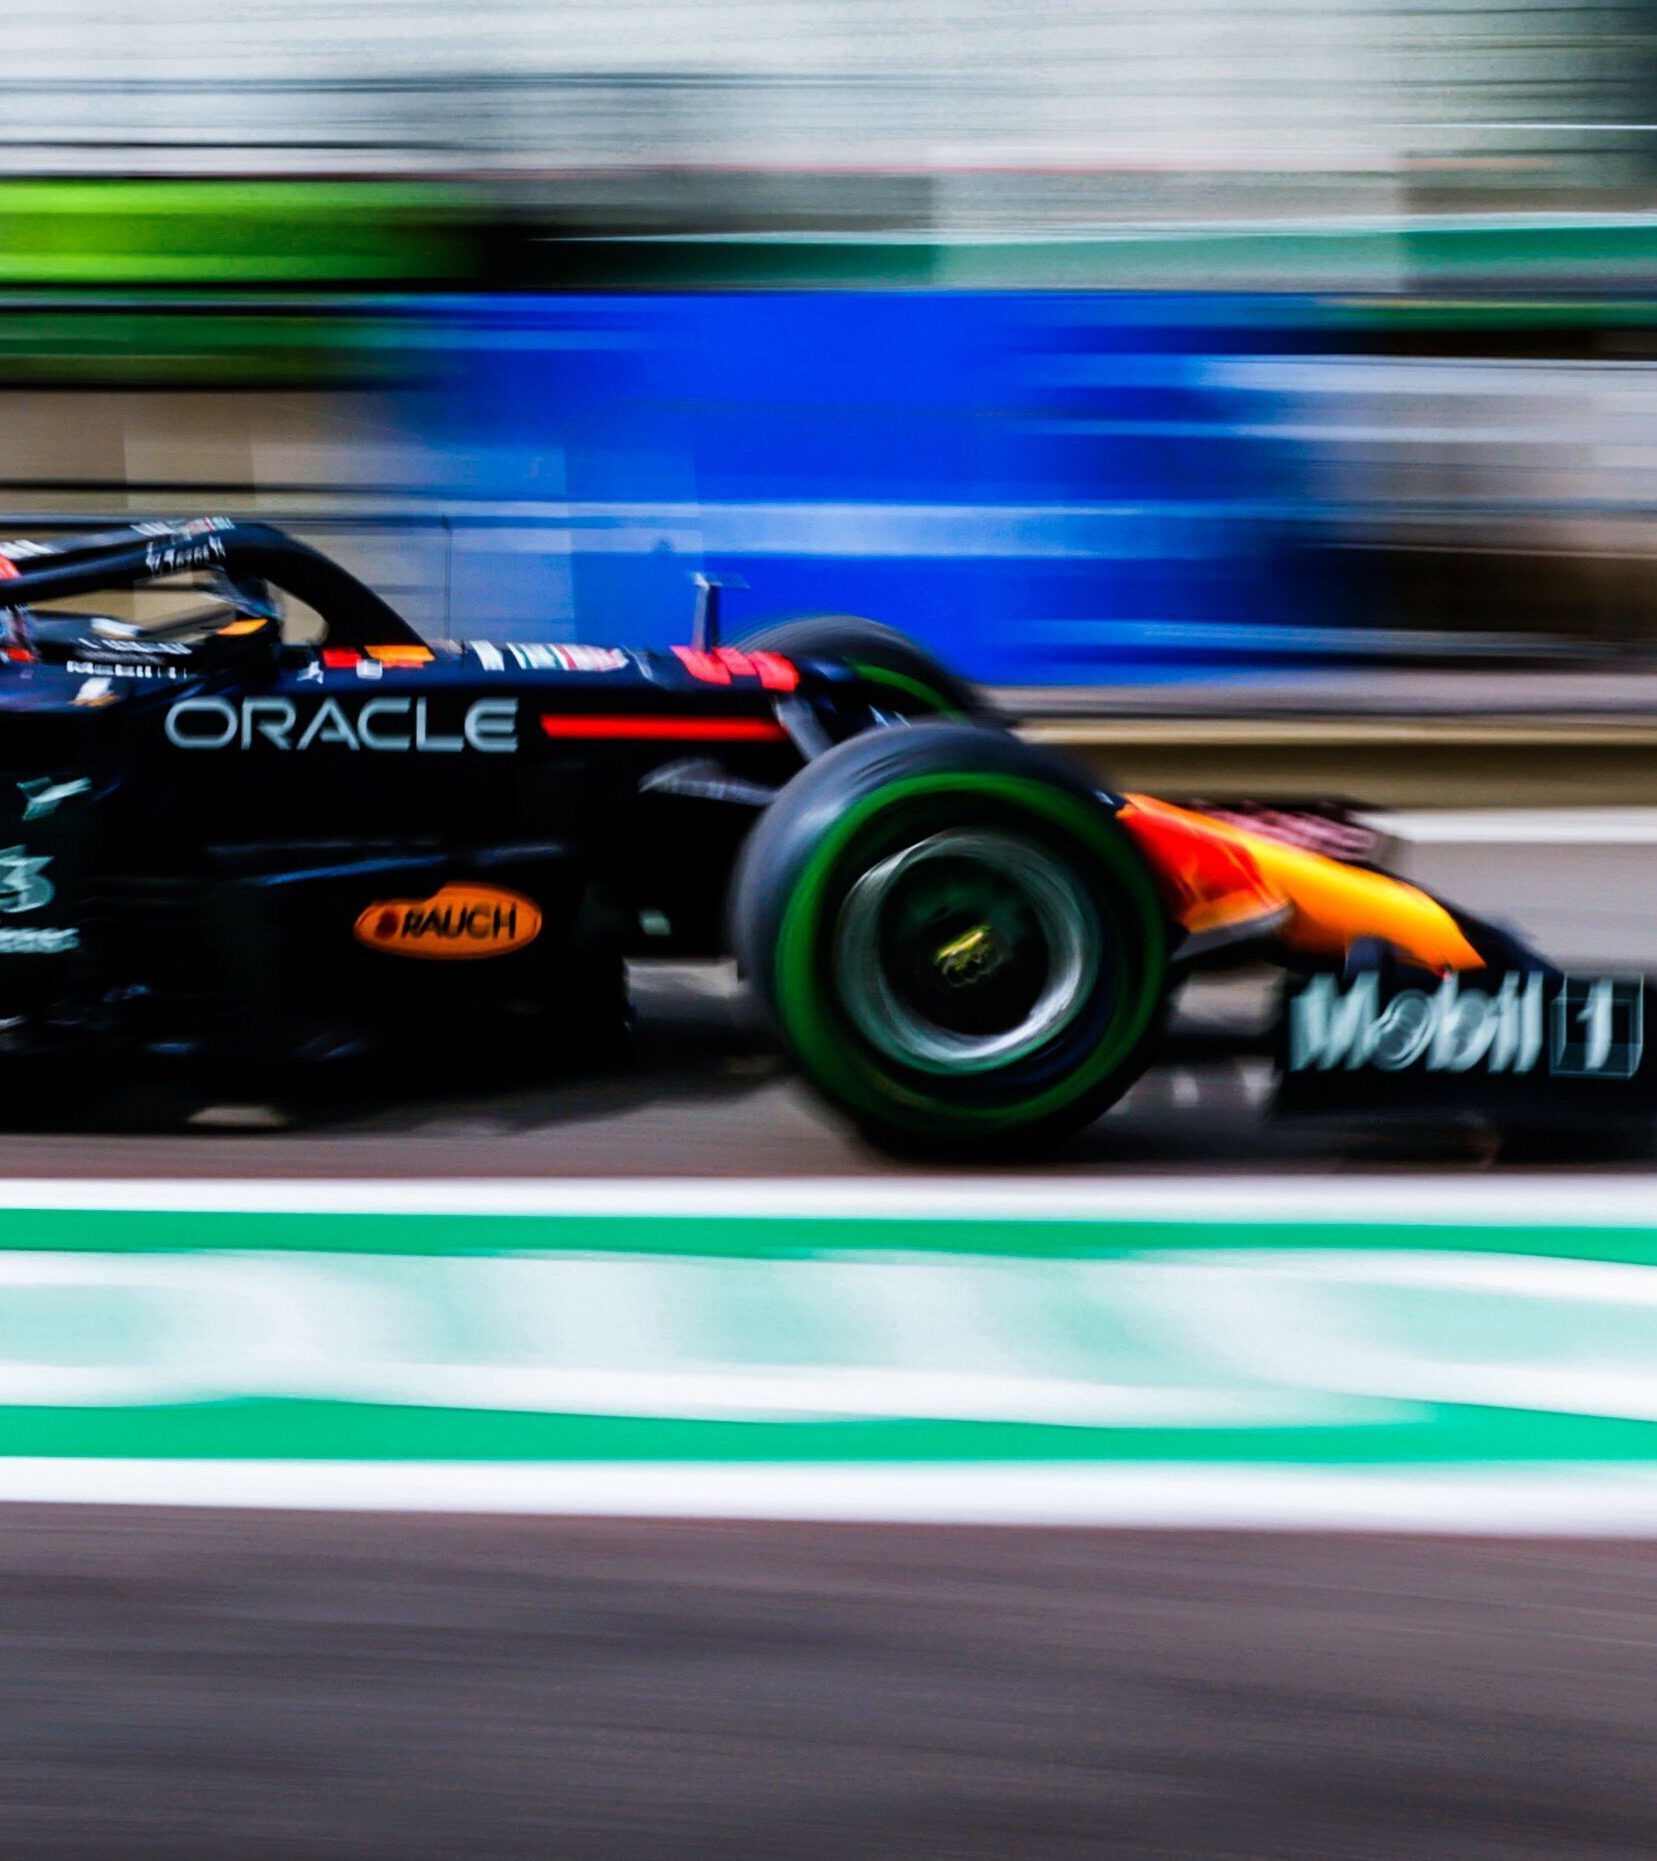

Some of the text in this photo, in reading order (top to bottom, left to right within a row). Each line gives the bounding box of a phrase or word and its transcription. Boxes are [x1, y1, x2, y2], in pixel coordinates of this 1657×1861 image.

[164, 696, 520, 752] ORACLE
[401, 906, 517, 941] RAUCH
[1289, 971, 1544, 1073] Mobil
